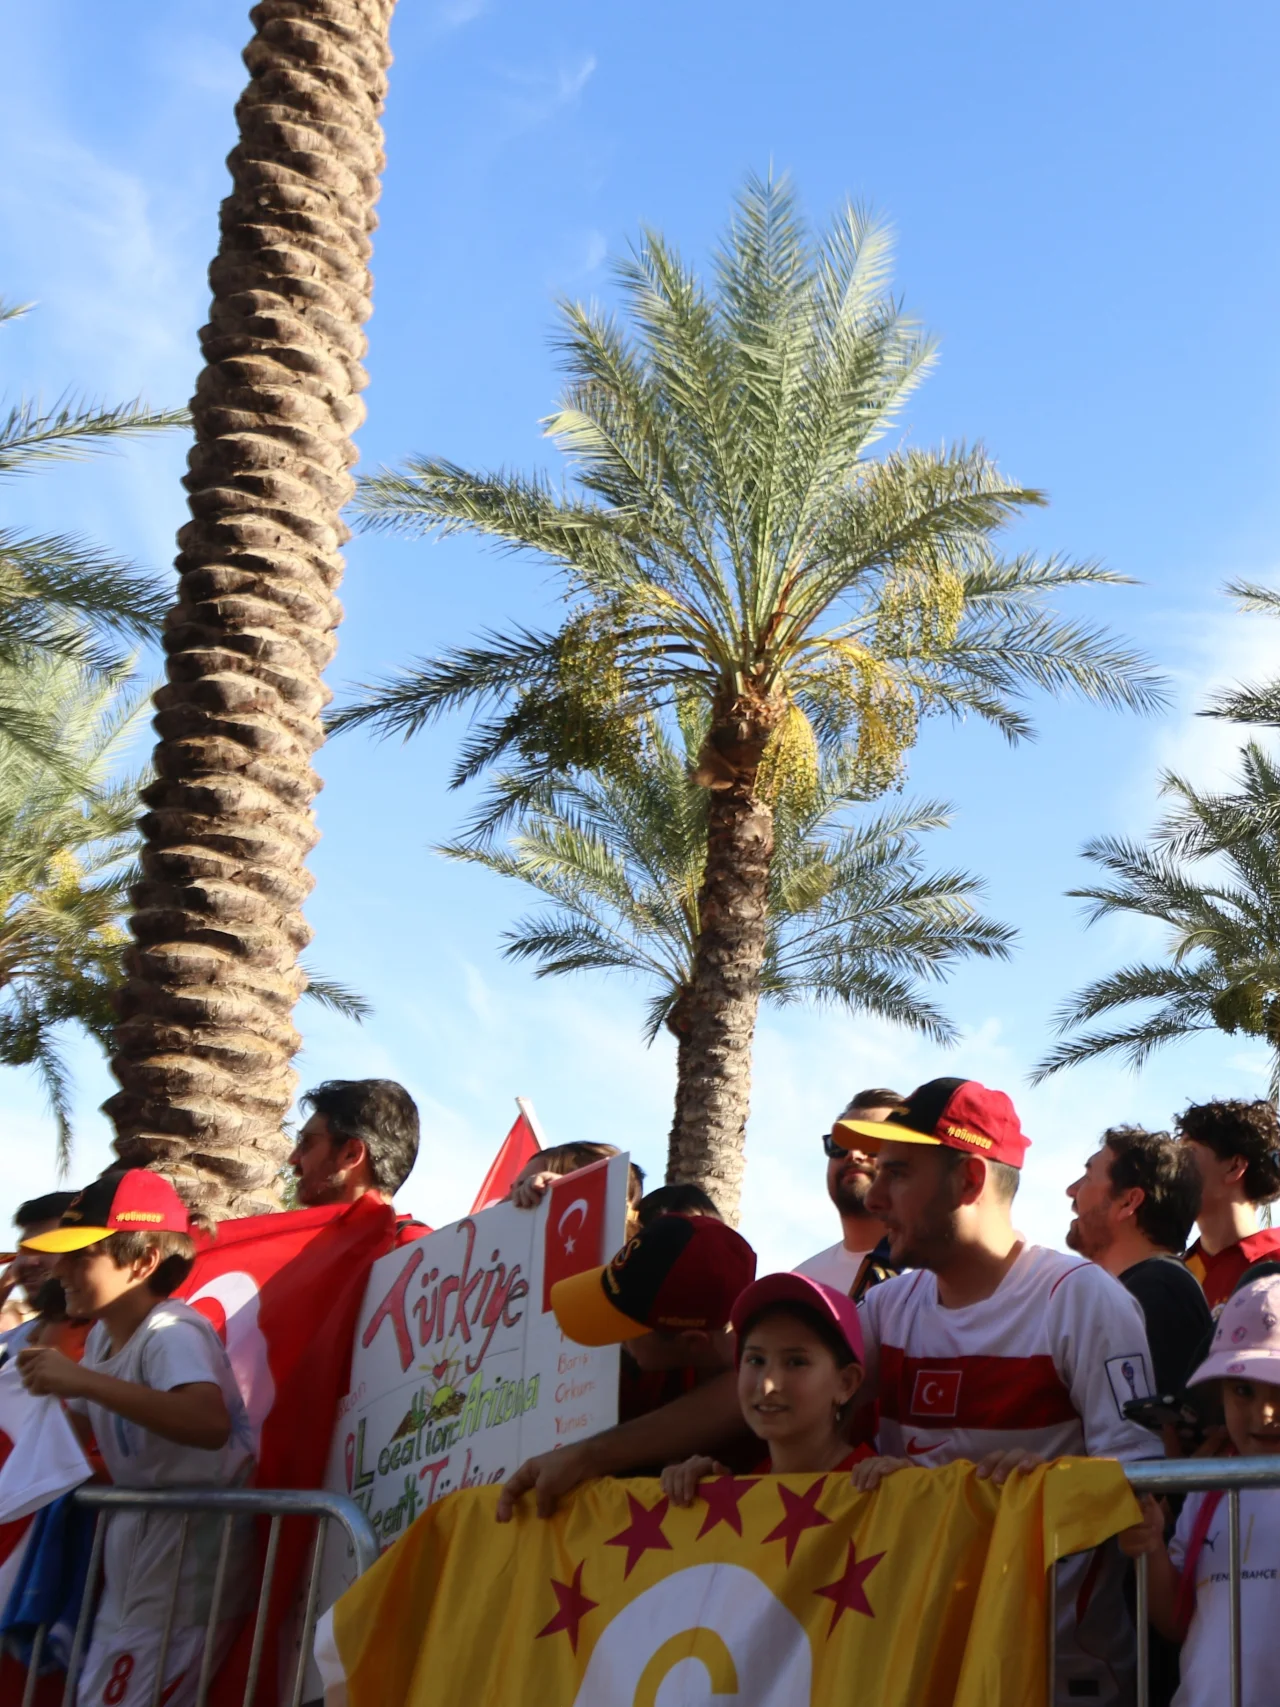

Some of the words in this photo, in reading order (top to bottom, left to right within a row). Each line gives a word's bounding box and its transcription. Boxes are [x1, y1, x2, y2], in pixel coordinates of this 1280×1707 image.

[361, 1218, 530, 1375] Türkiye
[457, 1370, 541, 1438] Arizona
[103, 1653, 135, 1705] 8
